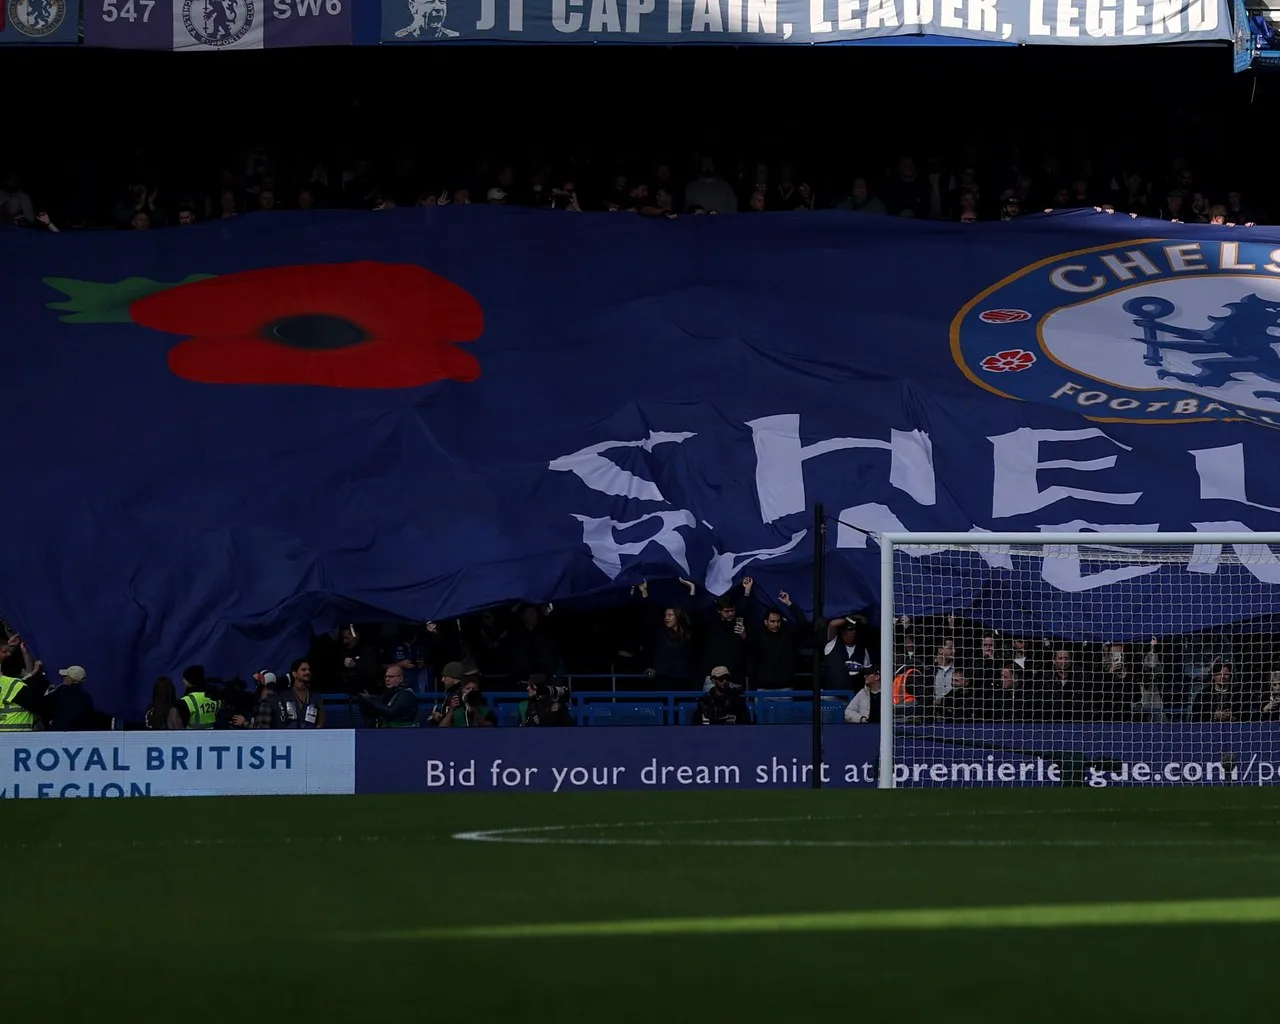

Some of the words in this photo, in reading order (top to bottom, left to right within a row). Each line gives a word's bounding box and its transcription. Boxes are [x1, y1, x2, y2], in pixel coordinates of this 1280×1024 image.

[14, 747, 130, 772] ROYAL
[146, 745, 293, 771] BRITISH
[427, 759, 476, 787] Bid
[490, 759, 538, 786] for
[552, 764, 626, 793] your
[640, 758, 741, 785] dream
[756, 756, 831, 784] shirt
[844, 761, 873, 783] at
